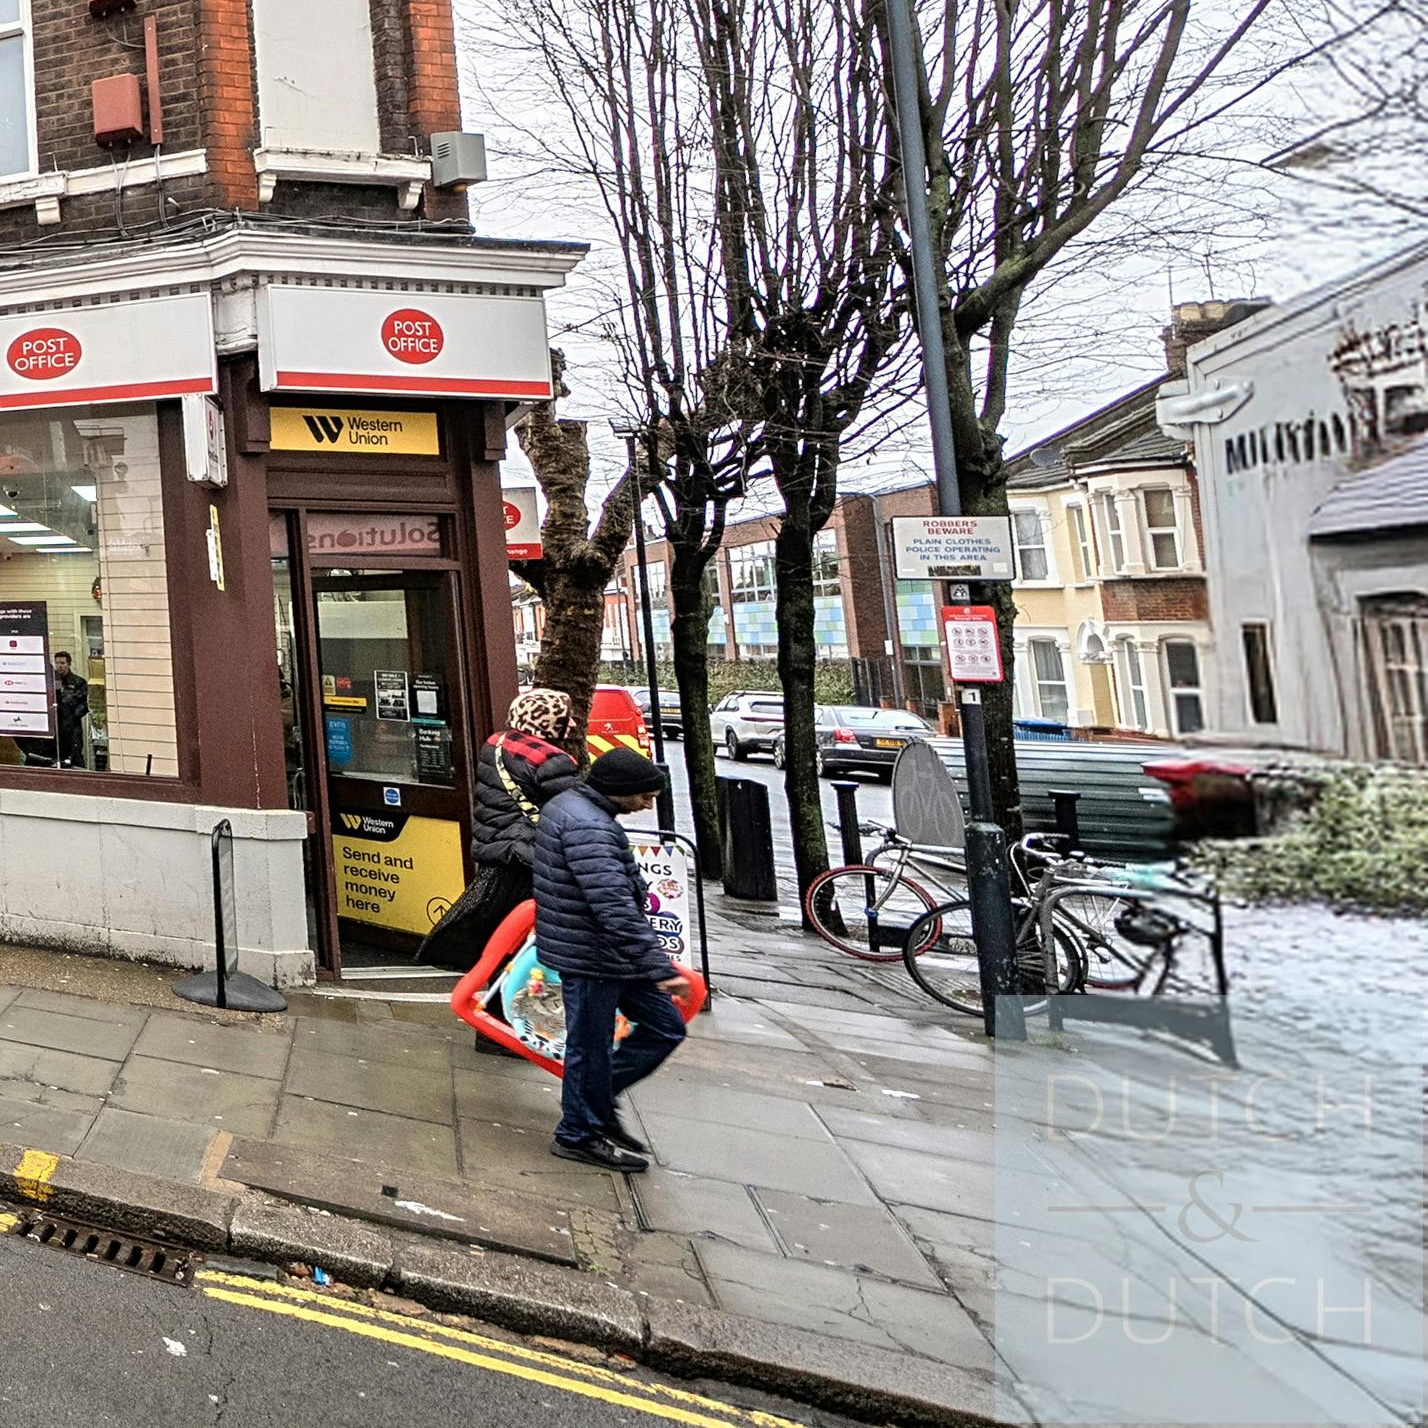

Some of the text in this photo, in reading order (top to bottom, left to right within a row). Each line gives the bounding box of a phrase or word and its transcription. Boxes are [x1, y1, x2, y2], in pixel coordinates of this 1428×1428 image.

[393, 320, 433, 337] POST
[22, 337, 68, 355] POST
[387, 337, 439, 354] OFFICE
[14, 352, 75, 371] OFFICE
[347, 416, 403, 433] Western
[349, 430, 389, 446] Union
[363, 816, 394, 828] Western
[363, 824, 386, 834] Union
[343, 846, 414, 870] Send and
[344, 864, 400, 884] receive
[345, 881, 396, 902] money
[346, 895, 380, 913] here
